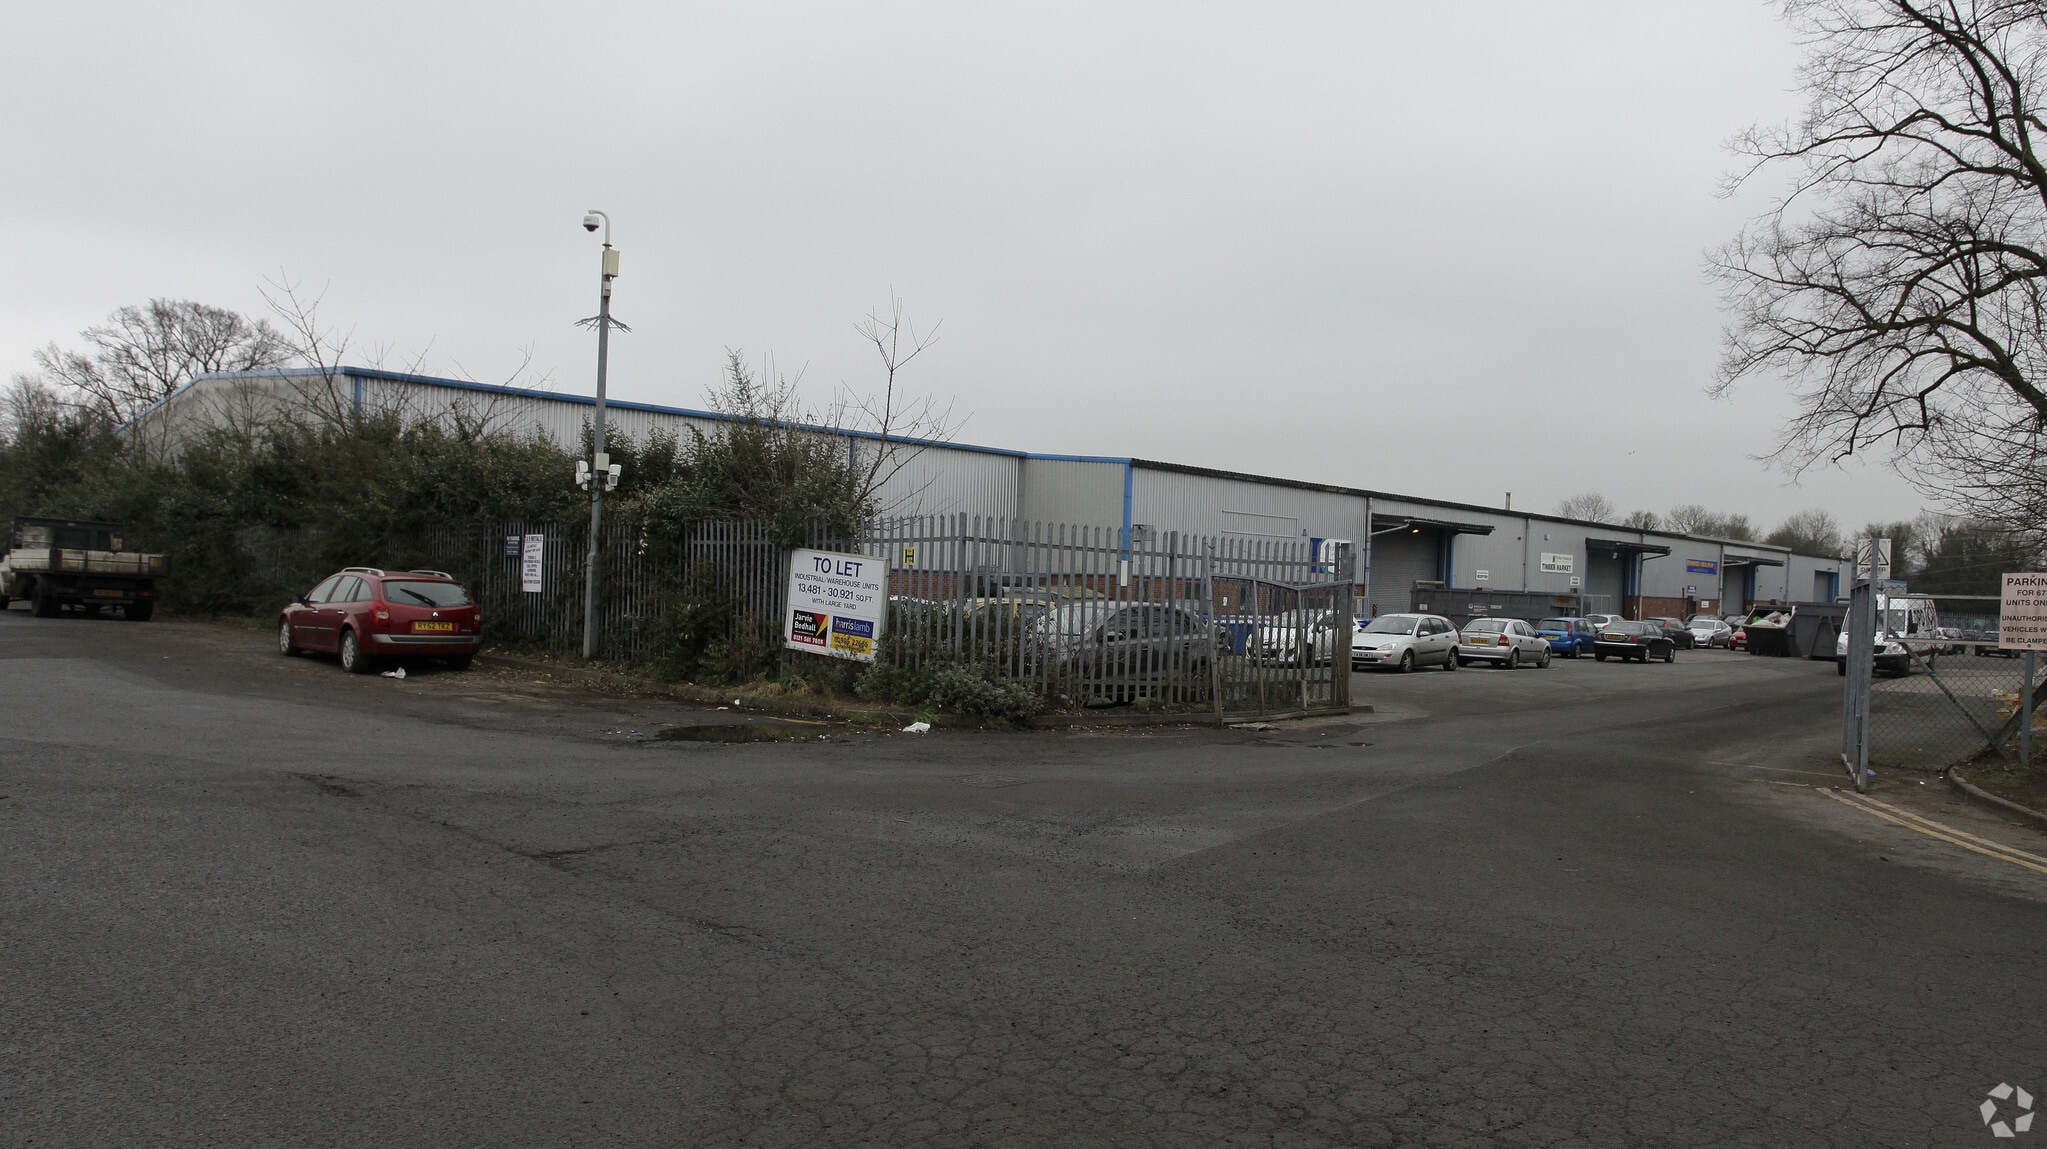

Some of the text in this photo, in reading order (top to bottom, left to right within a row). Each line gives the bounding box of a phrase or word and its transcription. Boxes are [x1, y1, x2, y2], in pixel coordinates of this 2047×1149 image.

[813, 556, 863, 578] TO LET
[795, 573, 824, 583] INDUSTRIAL
[827, 577, 861, 588] WAREHOUSE
[862, 583, 879, 591] UNITS
[798, 583, 821, 595] 13,481
[828, 587, 854, 600] 30,921
[2036, 589, 2046, 597] 67
[825, 600, 842, 608] LARGE
[843, 602, 856, 610] YARD
[795, 613, 813, 623] Jarvie
[794, 622, 816, 632] Bedhall
[835, 618, 870, 633] harrislamb
